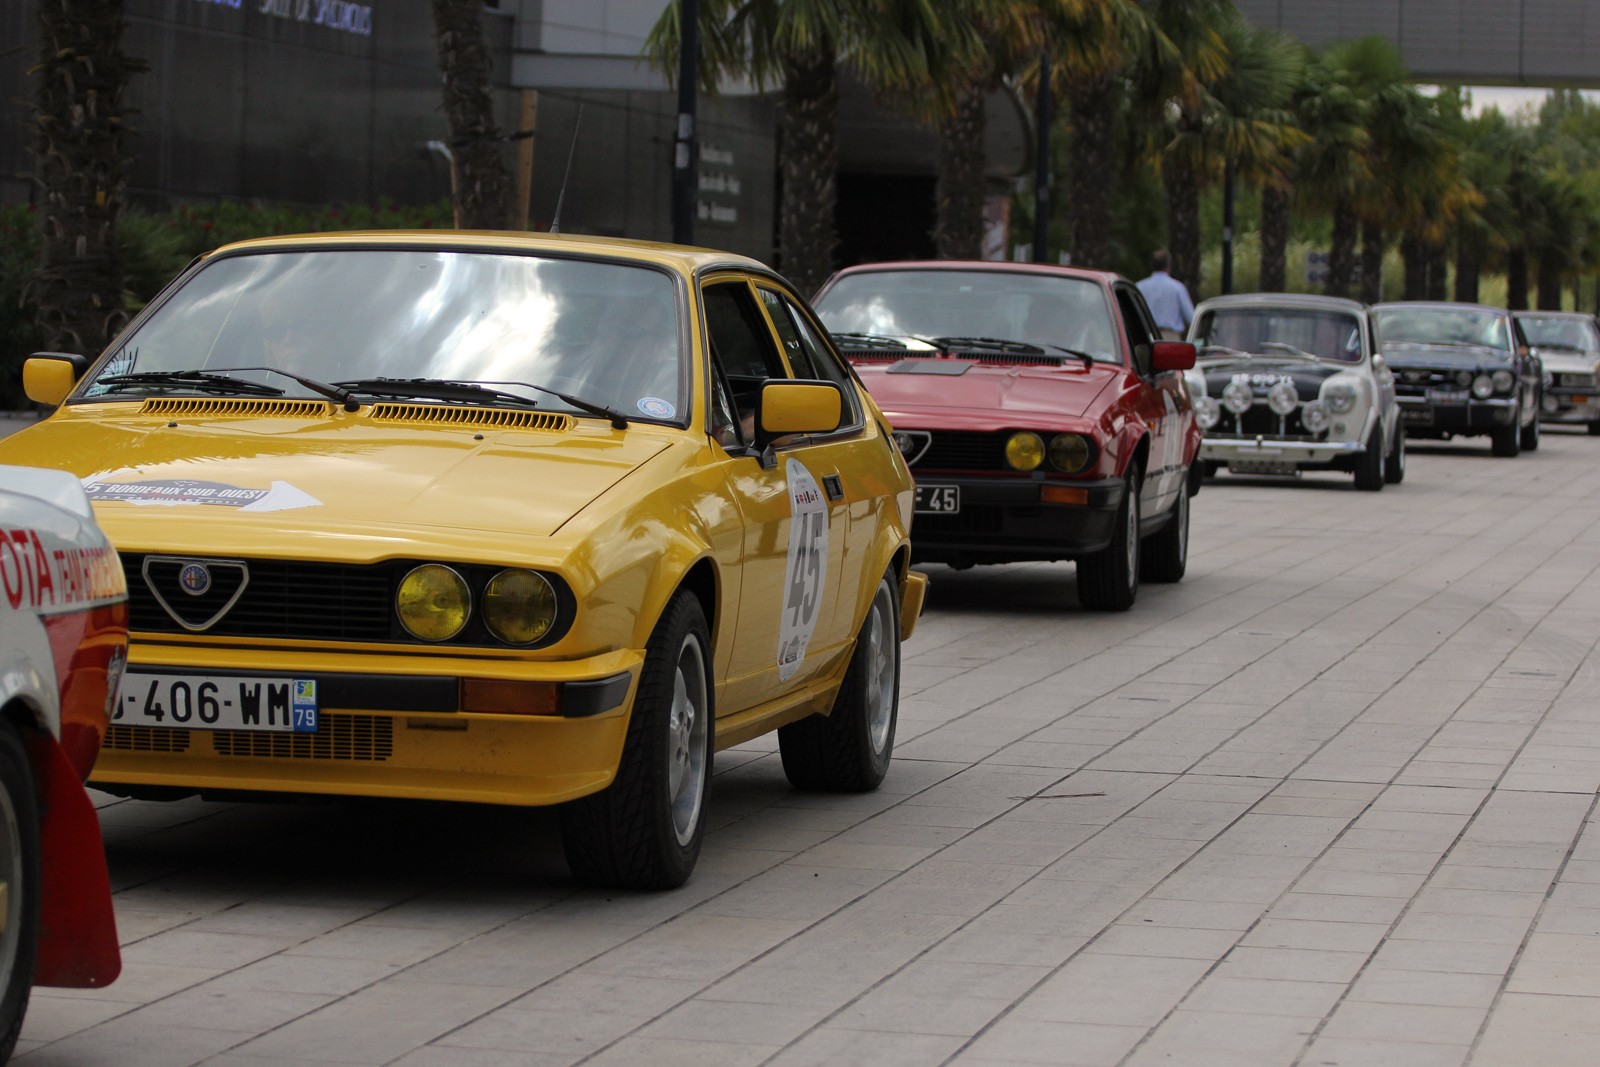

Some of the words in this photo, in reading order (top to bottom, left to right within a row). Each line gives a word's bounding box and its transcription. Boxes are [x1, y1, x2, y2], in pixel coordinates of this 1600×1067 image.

[105, 484, 185, 495] BORDEAUX
[184, 487, 271, 499] SUD-OUEST
[929, 487, 955, 512] 45
[53, 549, 84, 605] TEAM
[787, 512, 823, 627] 45
[112, 679, 291, 726] -406-WM
[294, 708, 316, 727] 79
